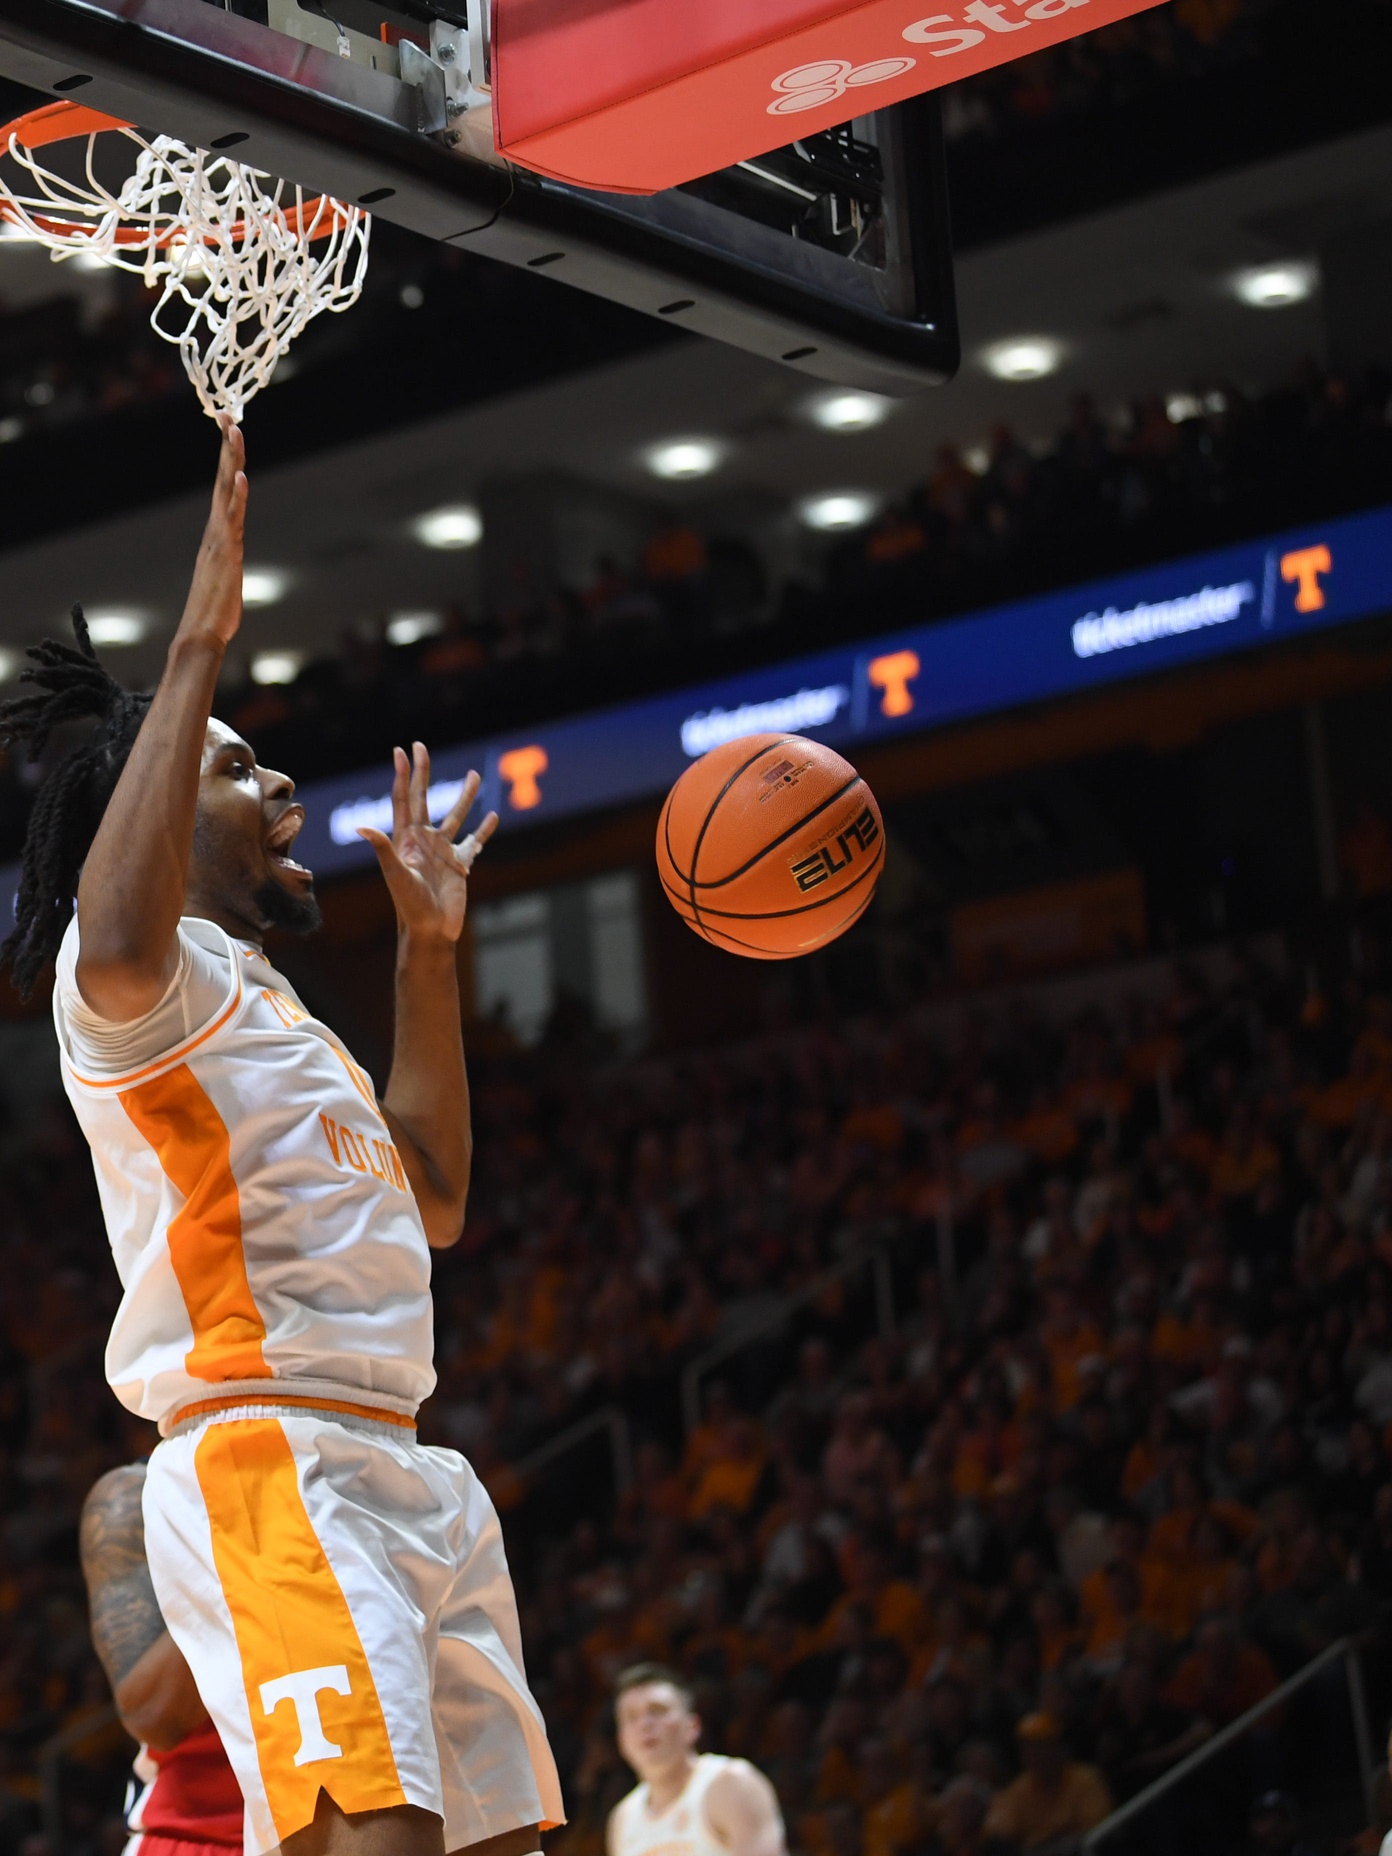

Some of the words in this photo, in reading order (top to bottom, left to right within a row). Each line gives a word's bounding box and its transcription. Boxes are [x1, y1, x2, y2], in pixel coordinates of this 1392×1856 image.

[902, 0, 1090, 57] Sta
[1280, 545, 1331, 613] T
[869, 650, 920, 718] T
[790, 806, 880, 893] ELITE
[259, 1665, 352, 1767] T
